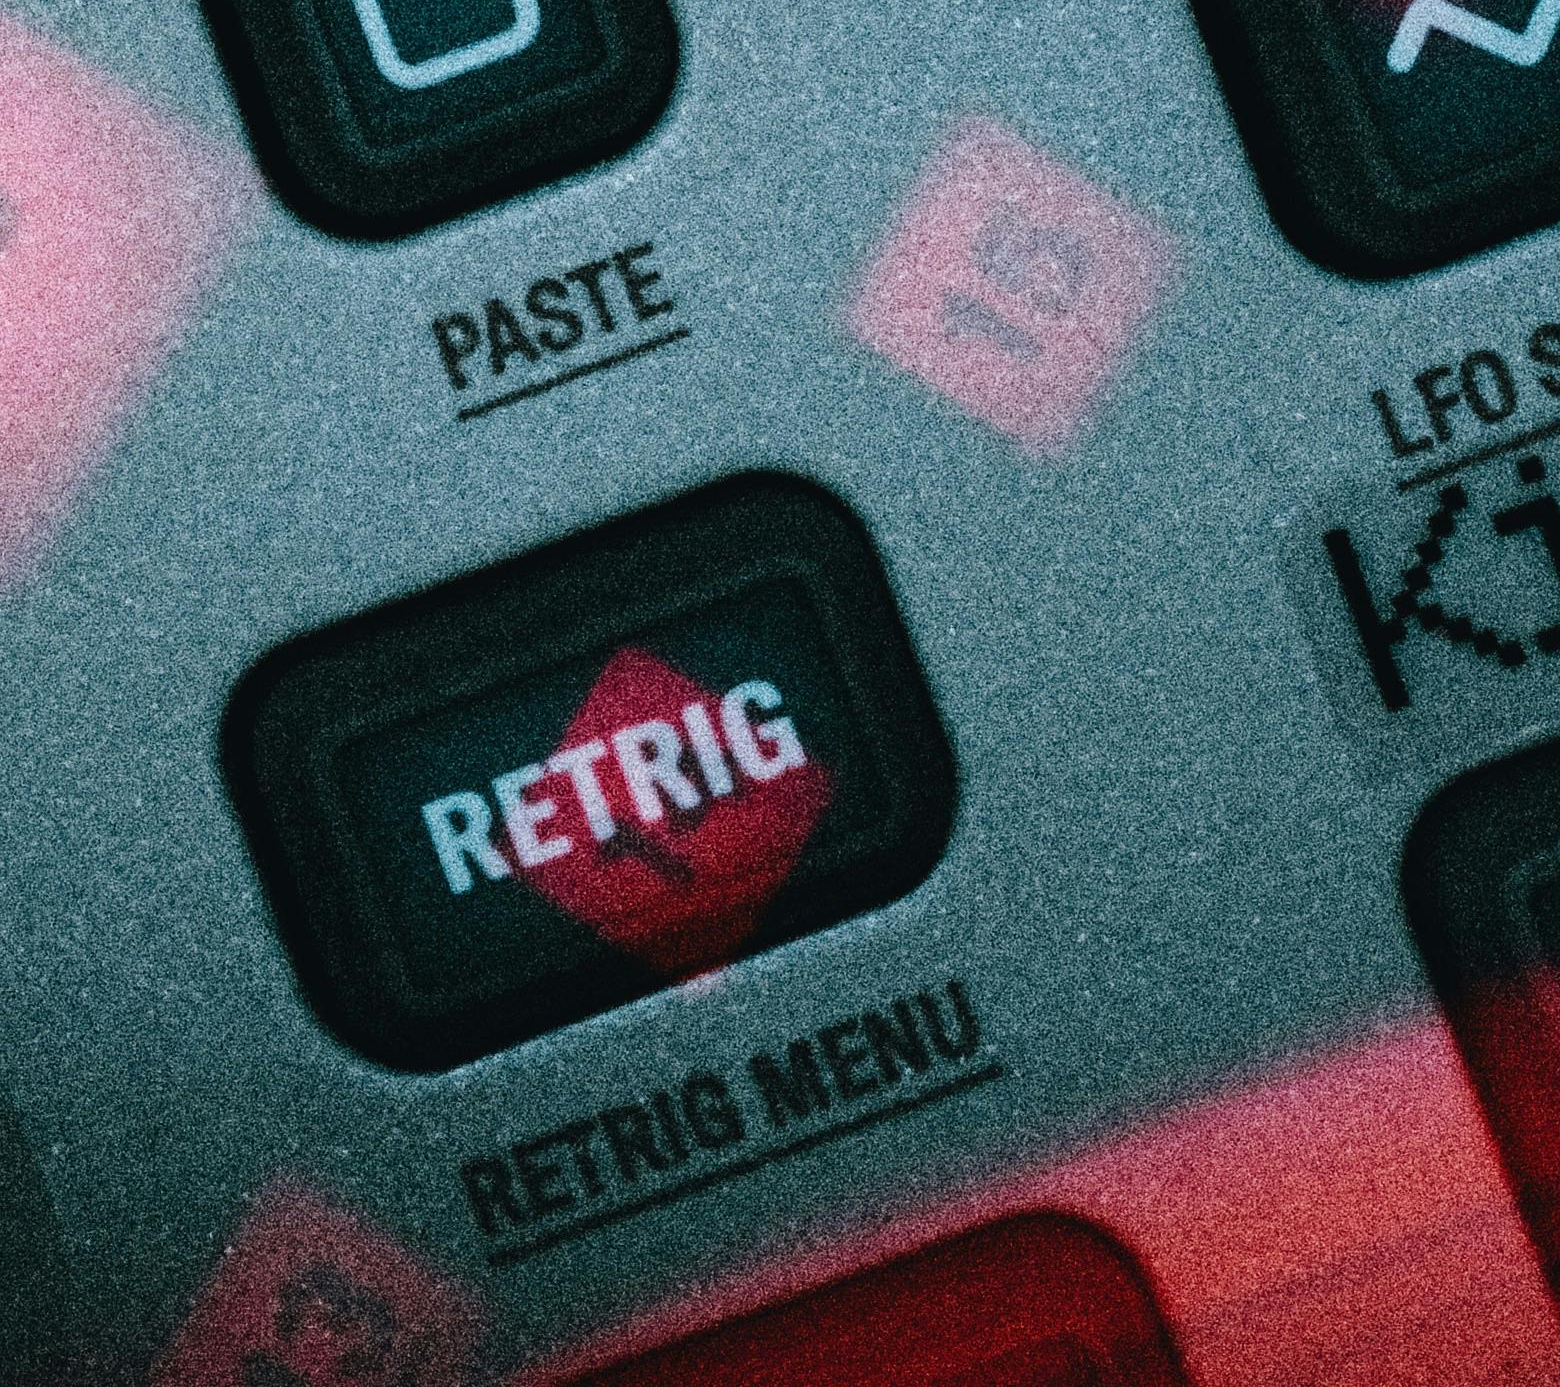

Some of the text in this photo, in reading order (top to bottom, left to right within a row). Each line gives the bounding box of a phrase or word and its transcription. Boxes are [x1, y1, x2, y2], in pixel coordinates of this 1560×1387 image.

[432, 241, 676, 393] PASTE
[1371, 348, 1517, 461] LFO
[420, 678, 808, 898] RETRIG
[459, 978, 984, 1242] RETRIG MENU
